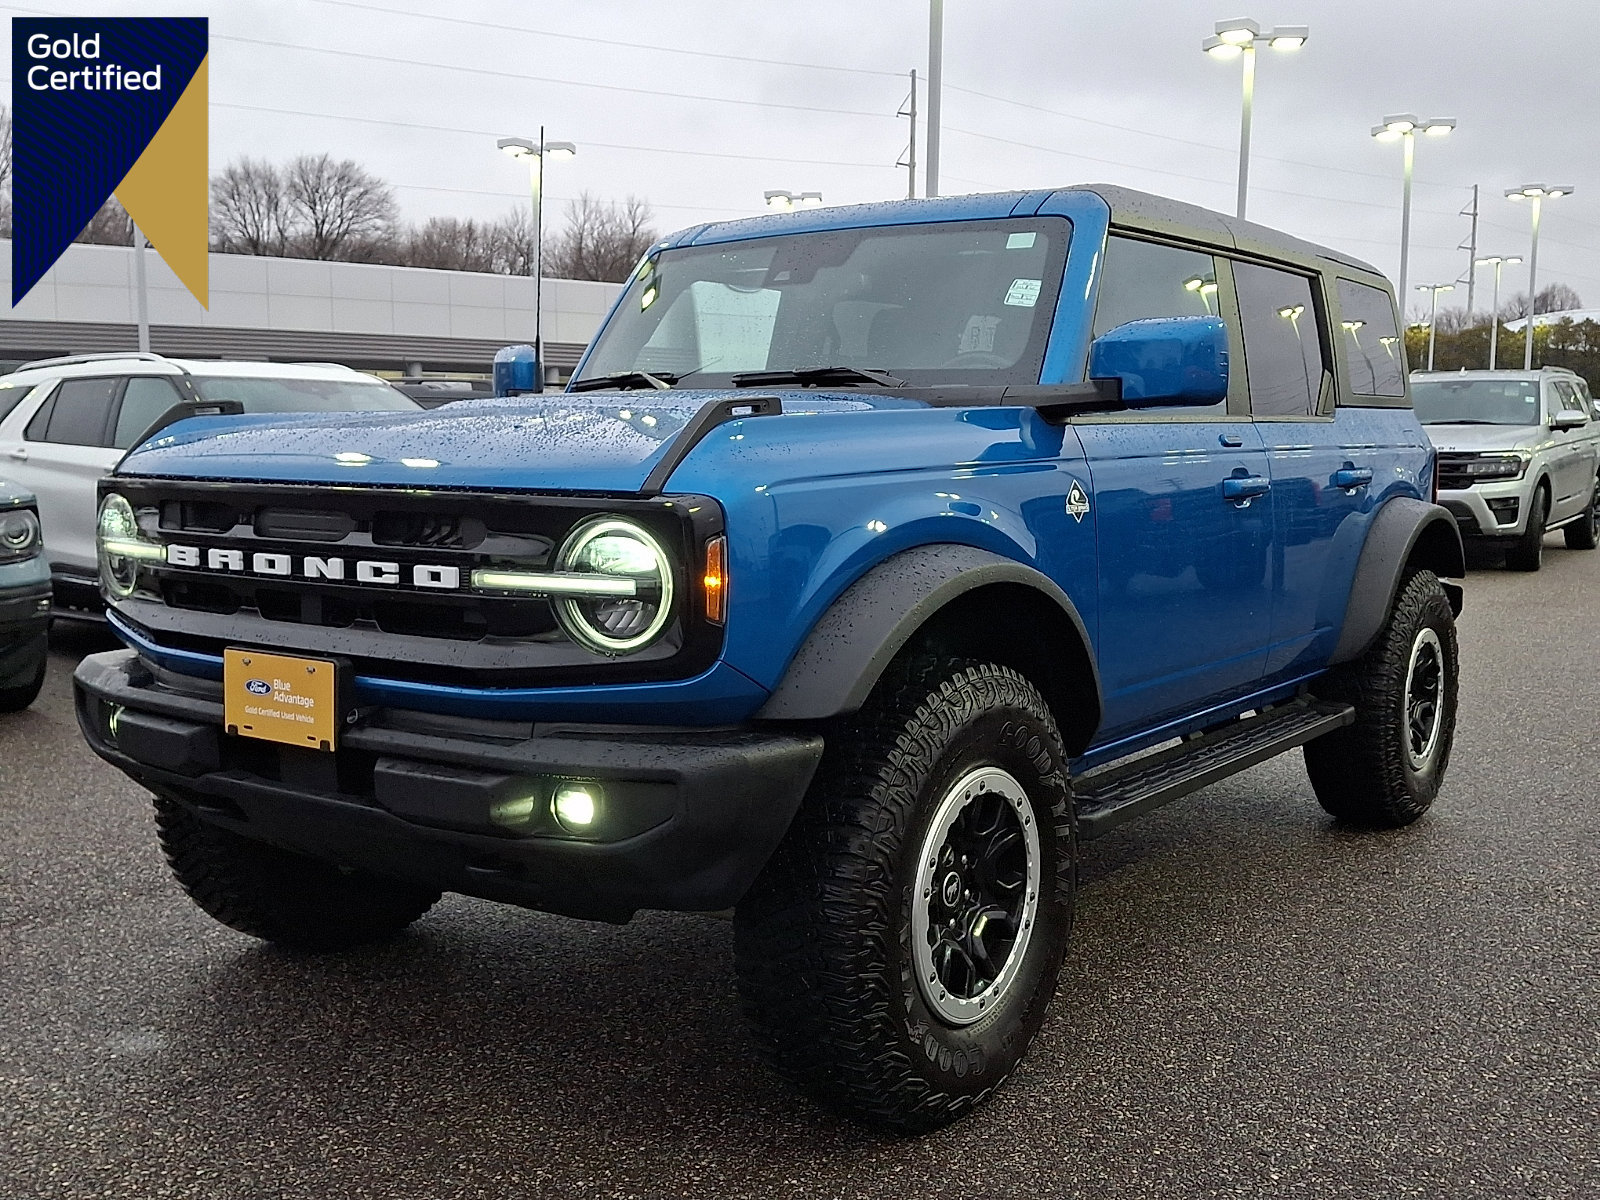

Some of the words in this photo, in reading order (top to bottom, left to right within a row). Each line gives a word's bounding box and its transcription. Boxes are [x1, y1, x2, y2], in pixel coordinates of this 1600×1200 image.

[166, 544, 460, 589] BRONCO
[248, 680, 268, 694] Ford
[273, 679, 291, 691] Blue
[273, 691, 315, 708] Advantage
[244, 705, 258, 715] Gold
[258, 708, 281, 718] Certified
[281, 711, 295, 720] Used
